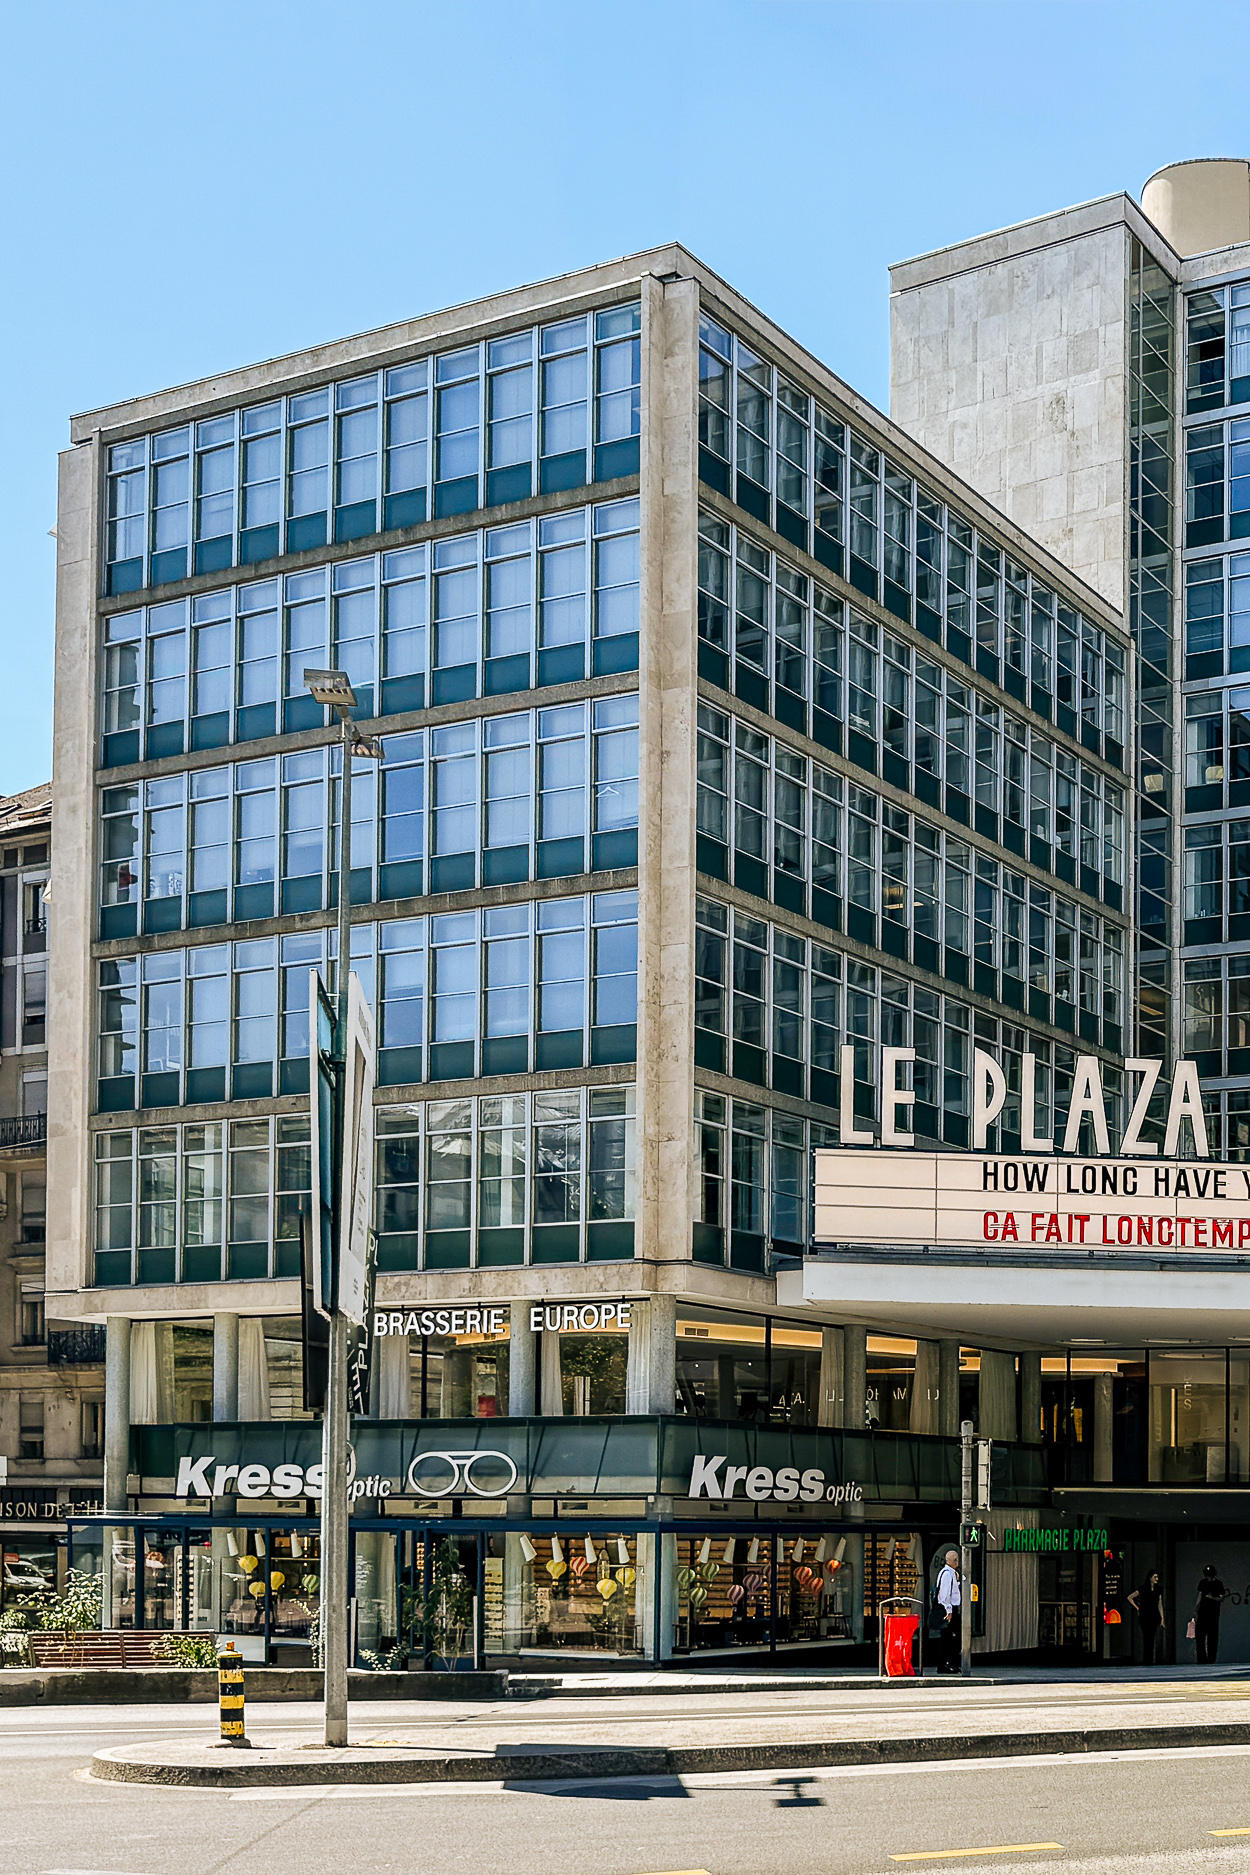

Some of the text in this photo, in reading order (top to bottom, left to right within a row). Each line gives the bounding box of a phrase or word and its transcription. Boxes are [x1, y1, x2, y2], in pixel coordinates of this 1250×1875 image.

[839, 1044, 1210, 1158] LE PLAZA
[982, 1161, 1049, 1192] HOW
[1154, 1167, 1227, 1199] HAVE
[1031, 1212, 1091, 1244] FAIT
[373, 1303, 632, 1337] BRASSERIE EUROPE
[349, 1474, 393, 1503] ptic
[687, 1454, 863, 1507] Kress optic
[1073, 1528, 1108, 1551] PLAZA
